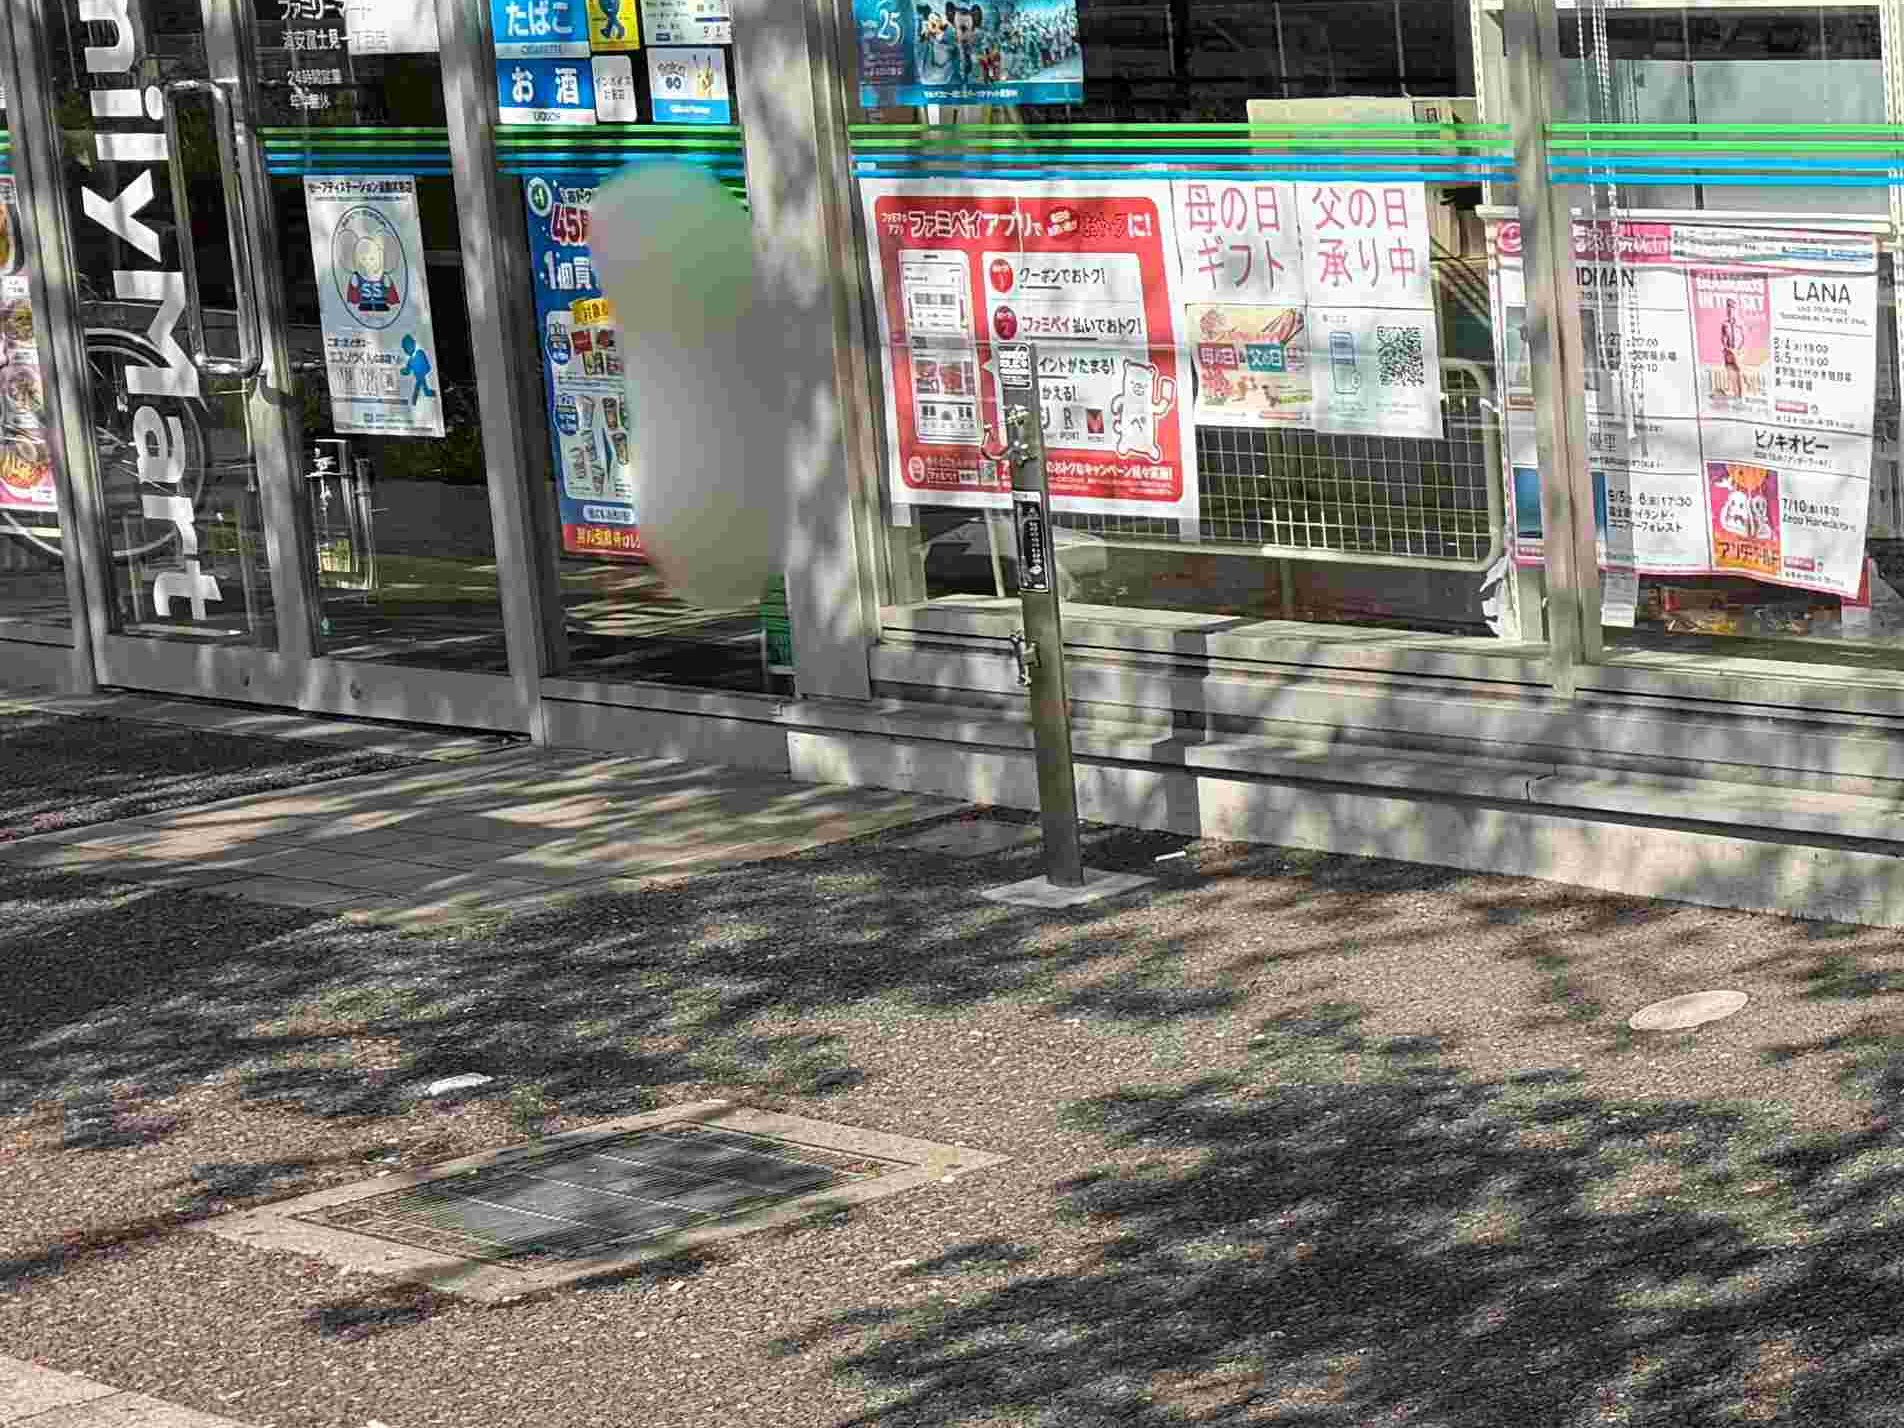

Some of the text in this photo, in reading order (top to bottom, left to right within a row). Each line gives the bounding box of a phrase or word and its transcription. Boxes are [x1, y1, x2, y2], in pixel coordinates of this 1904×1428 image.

[506, 0, 575, 37] たばこ
[511, 67, 580, 104] お酒
[1185, 184, 1408, 233] 母の日 父の日
[1198, 236, 1416, 290] ギフト 承り中
[1793, 280, 1852, 305] LANA
